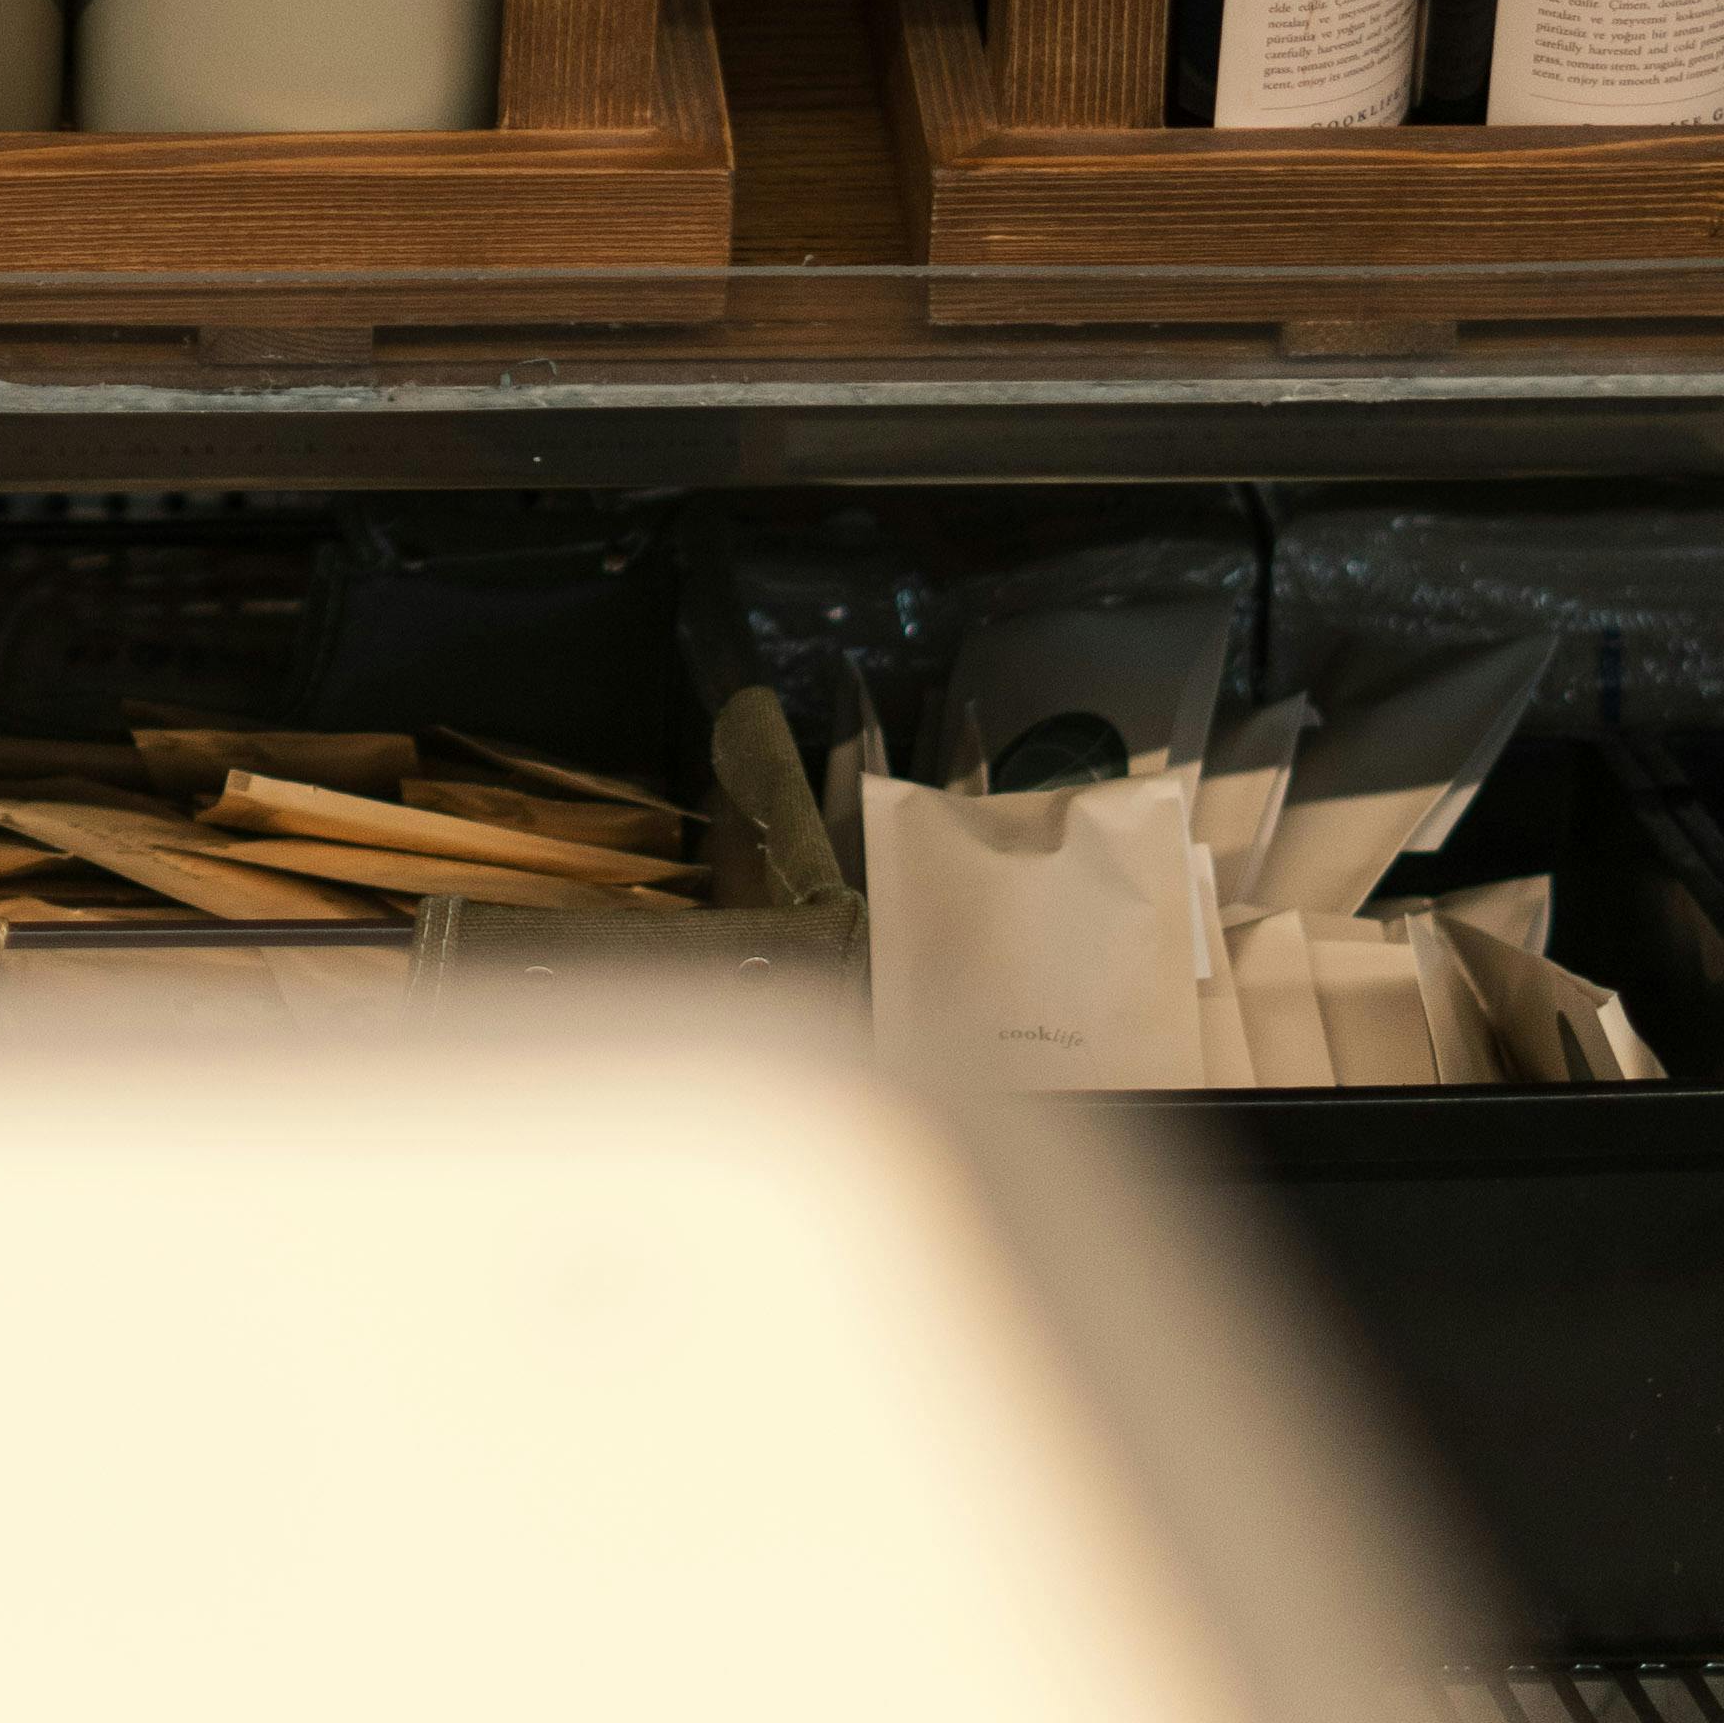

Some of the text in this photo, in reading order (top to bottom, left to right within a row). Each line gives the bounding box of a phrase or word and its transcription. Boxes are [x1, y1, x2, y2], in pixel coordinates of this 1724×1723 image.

[1267, 2, 1291, 14] elde
[1537, 6, 1667, 28] notaları ve meyvemsi
[1535, 22, 1705, 44] pürüzsüz ve yoğun bir aroma
[1264, 46, 1313, 61] carefully
[1317, 34, 1363, 56] harvested
[1534, 36, 1697, 57] carefully harvested and cold
[1263, 65, 1294, 78] grass,
[1297, 59, 1335, 74] tomato
[1532, 52, 1715, 73] grass, tomato stem, arugula, green
[1262, 79, 1295, 91] scent,
[1297, 74, 1327, 90] enjoy
[1329, 72, 1342, 84] its
[1531, 67, 1564, 81] scent,
[1566, 73, 1599, 88] enjoy
[1601, 75, 1616, 86] its
[1618, 74, 1661, 87] smooth
[1664, 72, 1684, 84] and
[997, 1025, 1085, 1050] cooklife
